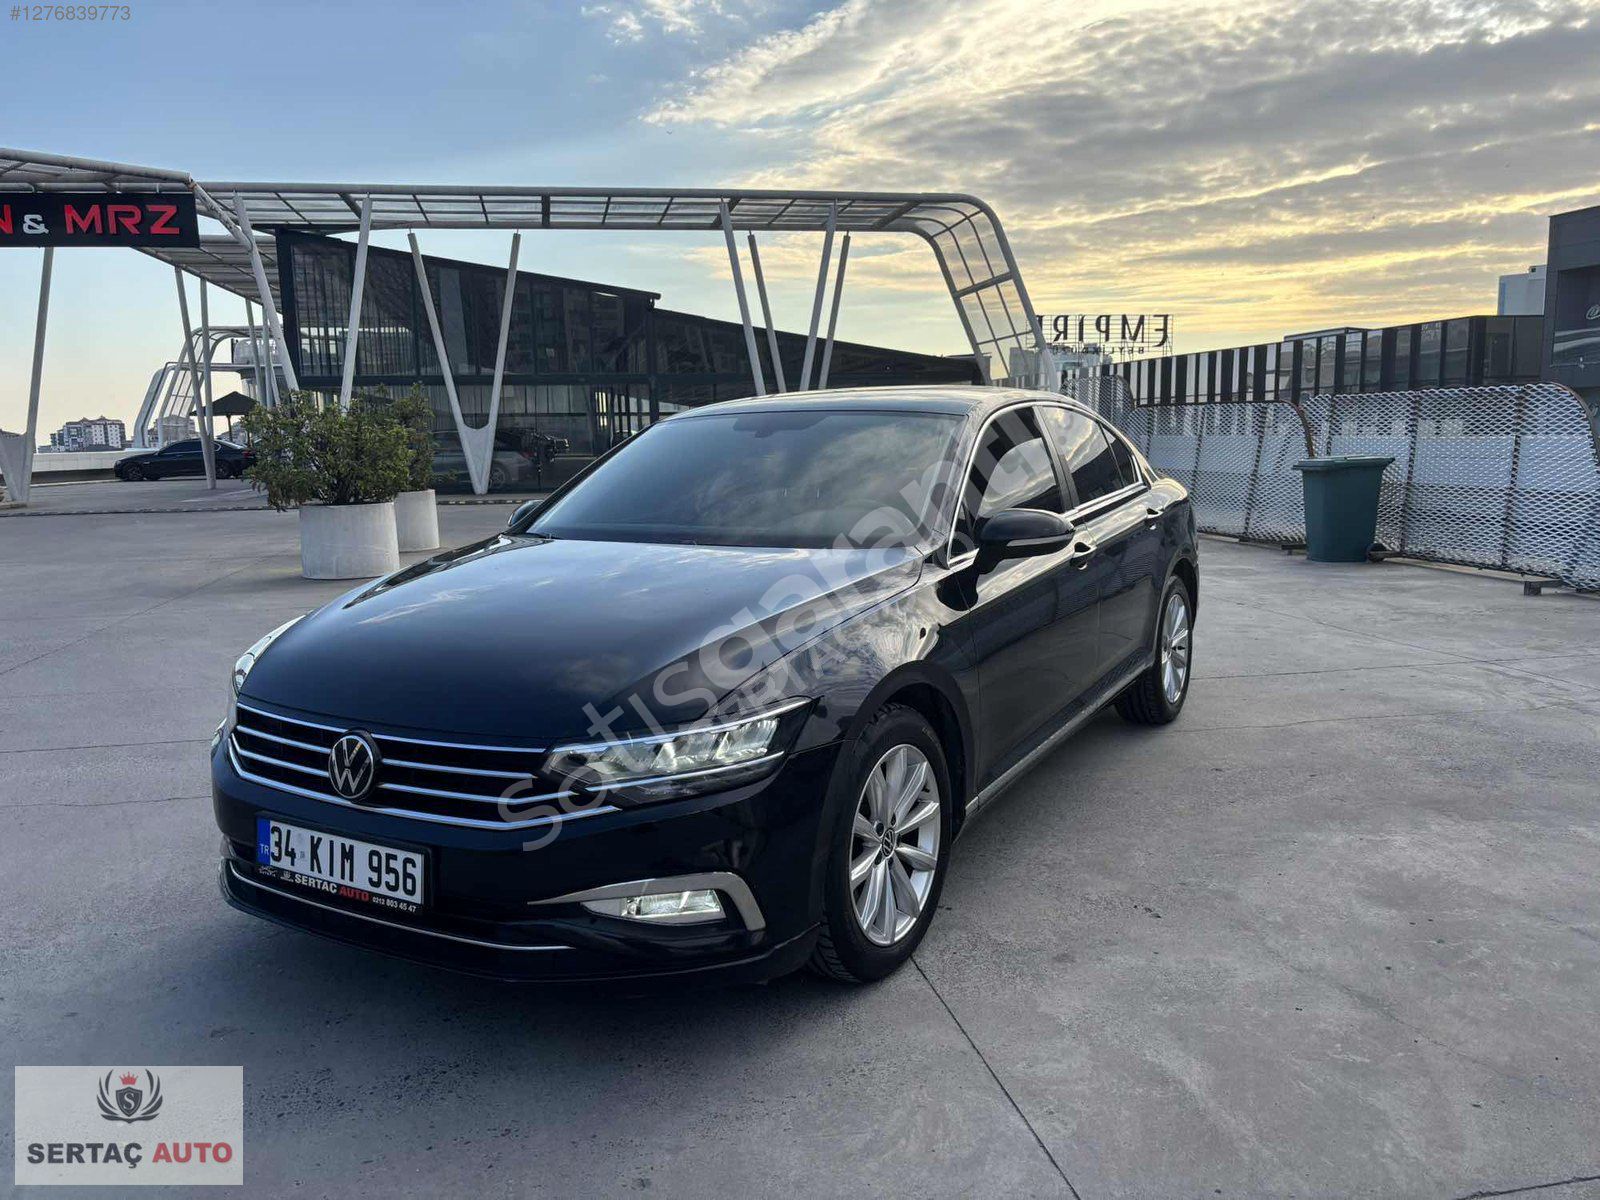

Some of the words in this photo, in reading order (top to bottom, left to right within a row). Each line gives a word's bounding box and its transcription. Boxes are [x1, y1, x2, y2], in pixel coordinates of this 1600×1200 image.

[22, 214, 50, 235] &
[64, 204, 180, 235] MRZ
[260, 843, 270, 855] TR
[271, 826, 296, 867] 34
[310, 835, 354, 882] KIM
[367, 849, 417, 897] 956
[339, 886, 369, 901] AUTO
